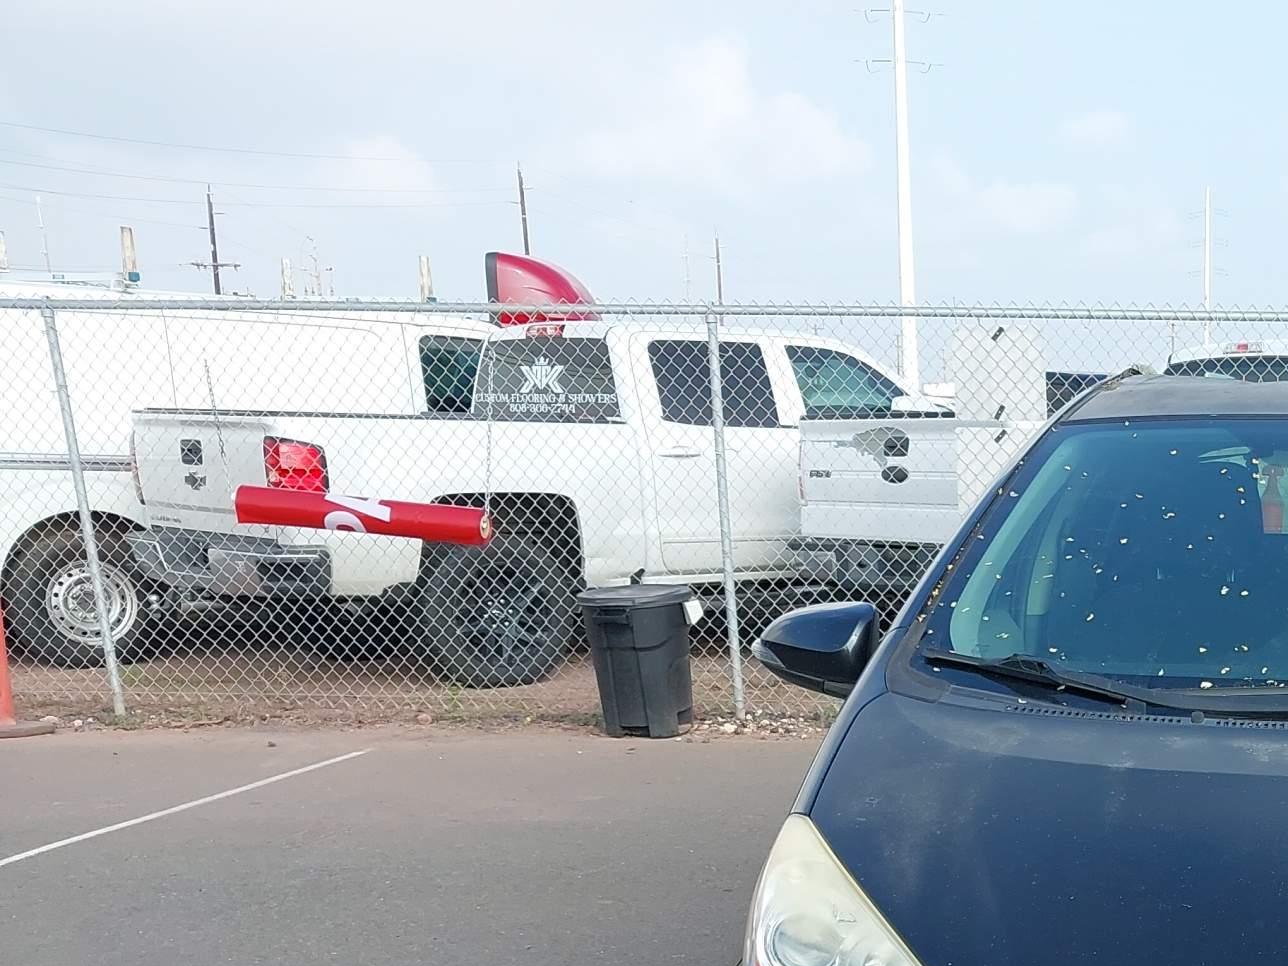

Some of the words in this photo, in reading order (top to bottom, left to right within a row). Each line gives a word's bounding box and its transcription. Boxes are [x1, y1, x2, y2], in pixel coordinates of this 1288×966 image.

[475, 393, 509, 403] CUSTOM
[511, 393, 556, 403] FLOORING
[568, 393, 617, 404] SHOWERS
